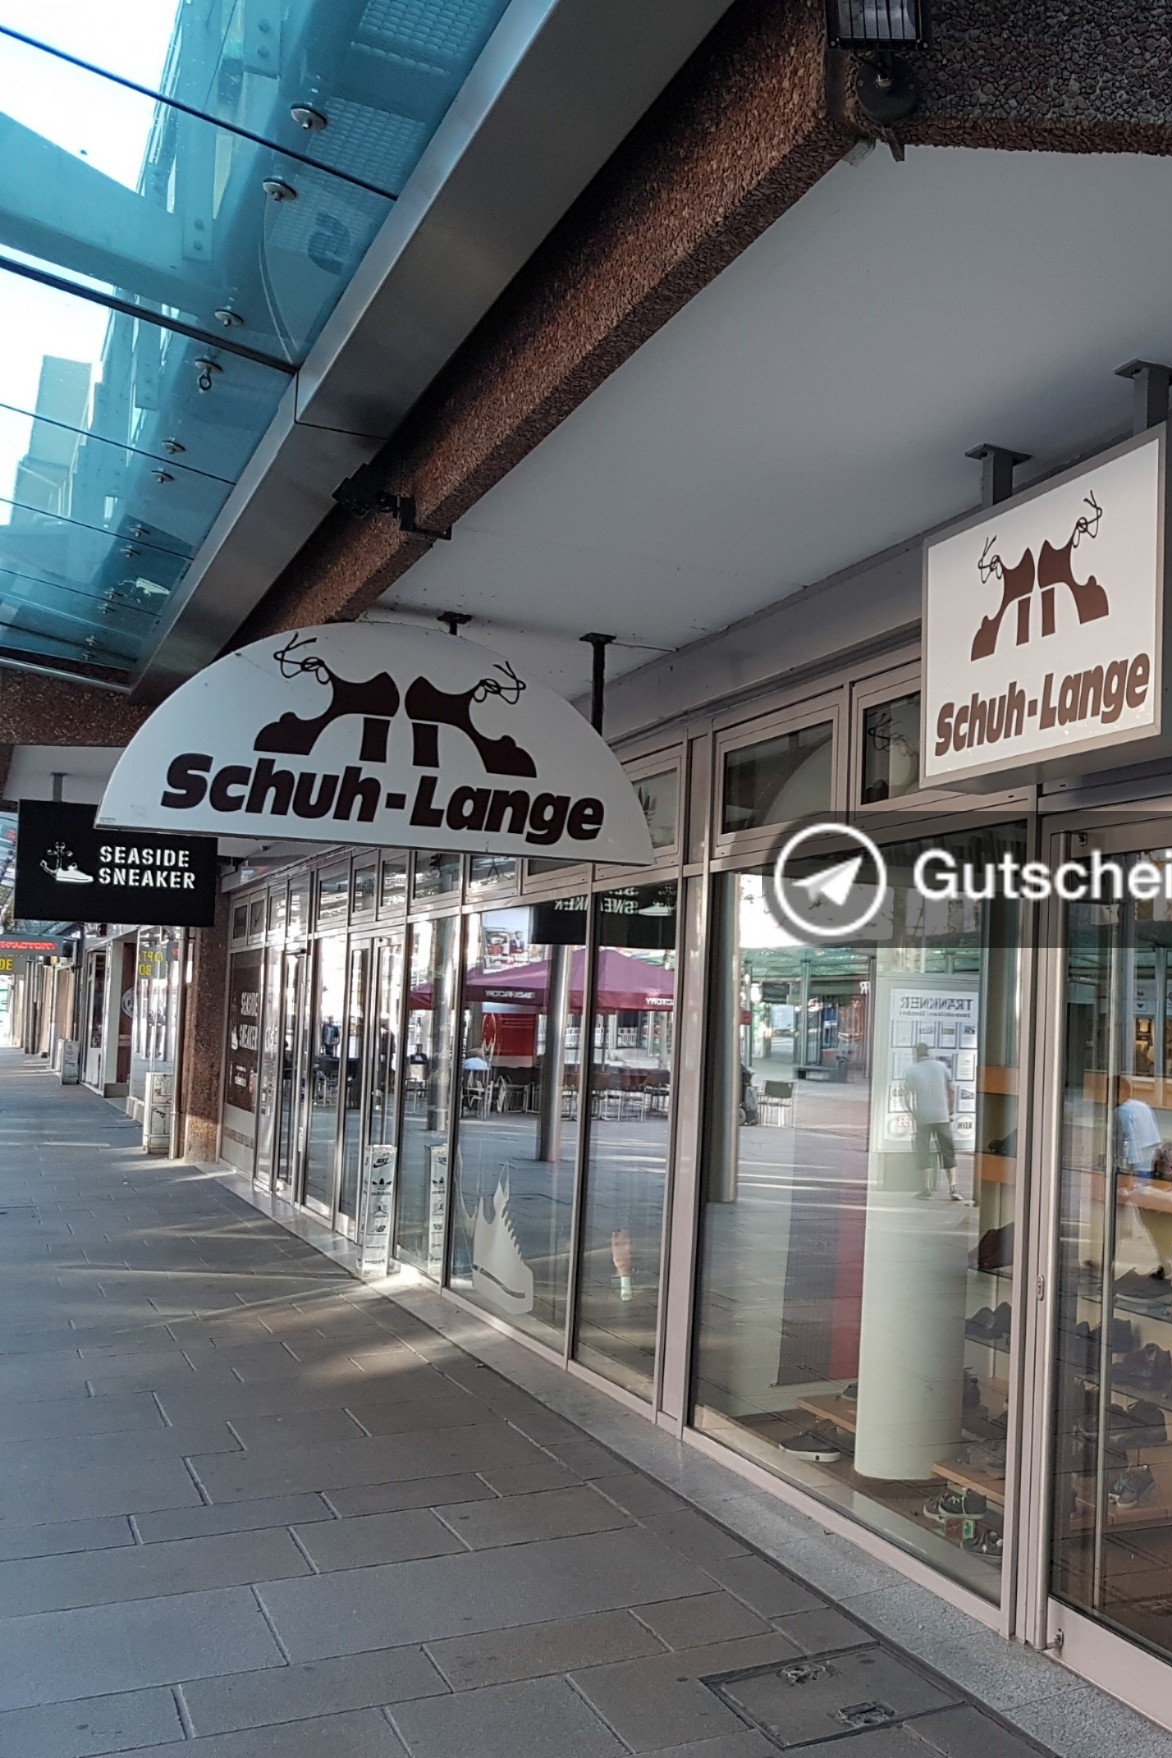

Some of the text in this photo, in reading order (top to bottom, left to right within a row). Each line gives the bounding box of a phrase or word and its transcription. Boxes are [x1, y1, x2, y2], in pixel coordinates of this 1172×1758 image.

[935, 652, 1151, 758] Schuh-Lange
[160, 752, 605, 846] Schuh-Lange
[98, 867, 196, 890] SNEAKER
[99, 845, 190, 868] SEASIDE
